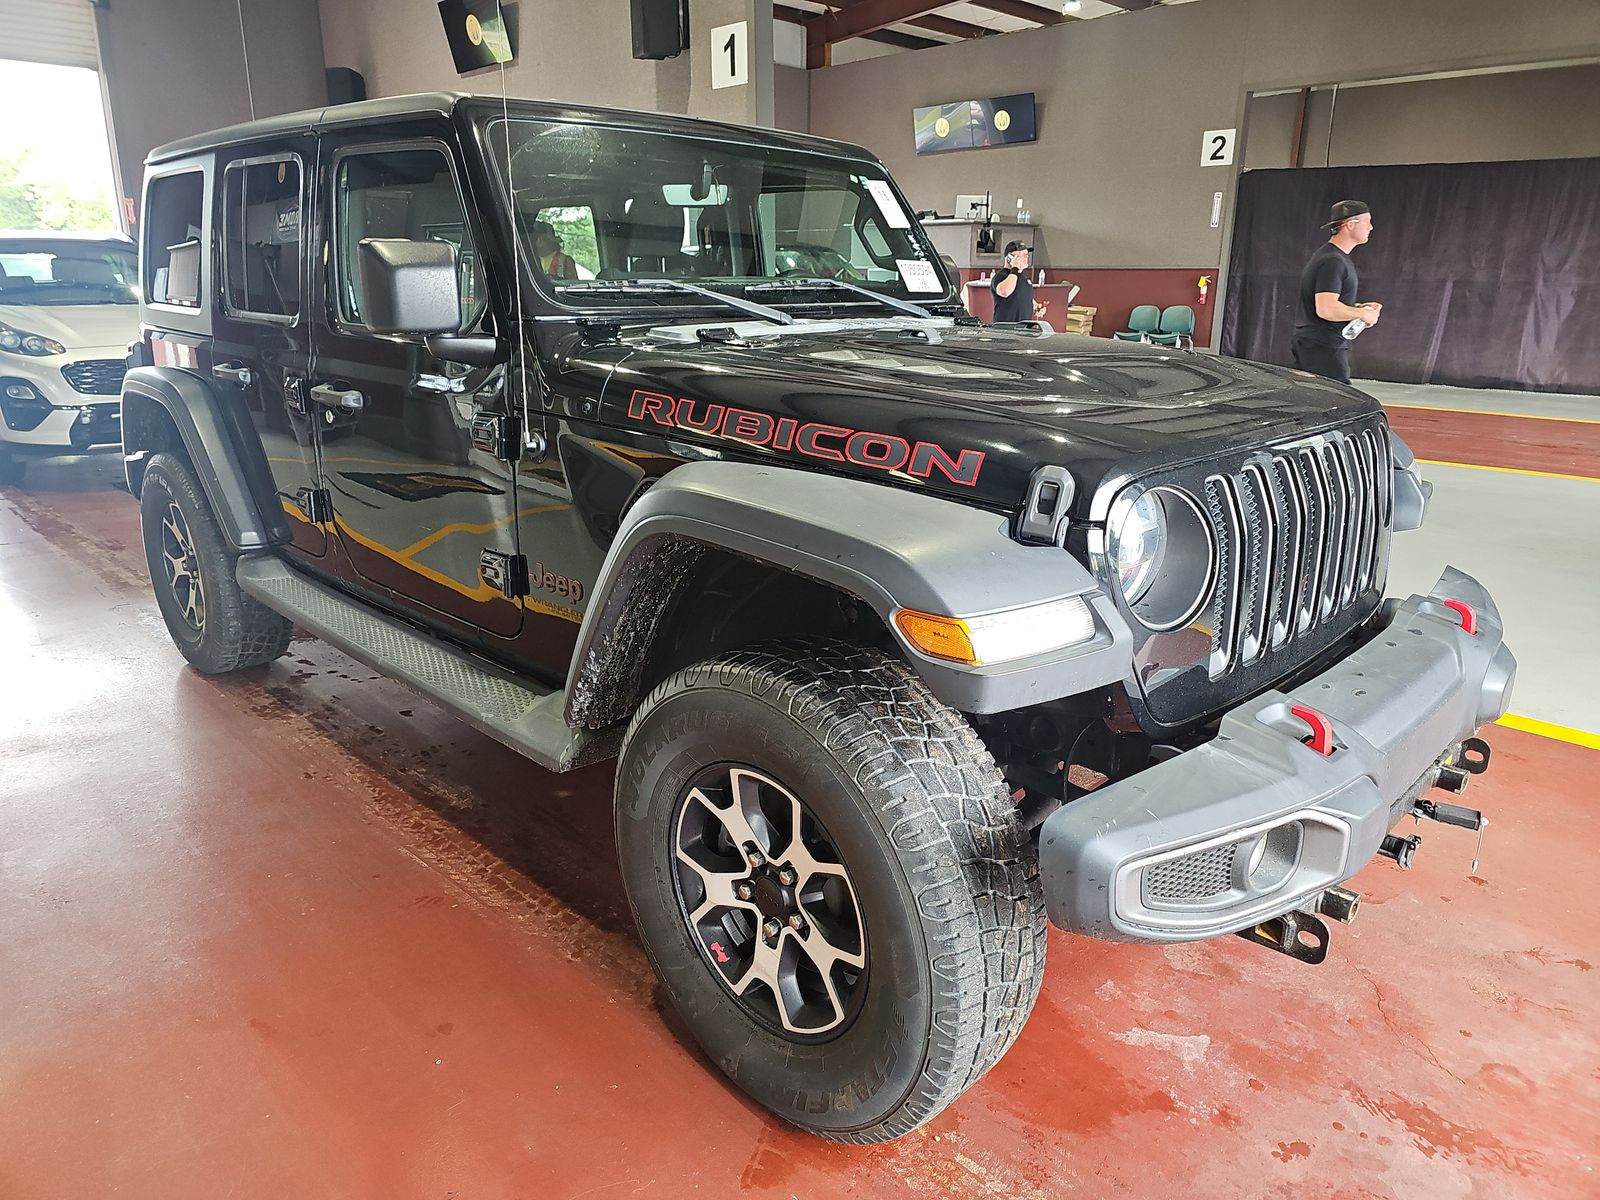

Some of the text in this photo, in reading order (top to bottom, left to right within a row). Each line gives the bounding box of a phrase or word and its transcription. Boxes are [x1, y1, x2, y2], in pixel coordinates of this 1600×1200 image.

[723, 33, 736, 77] 1
[1209, 135, 1227, 161] 2
[627, 389, 986, 487] RUBICON
[529, 561, 584, 605] Jeep
